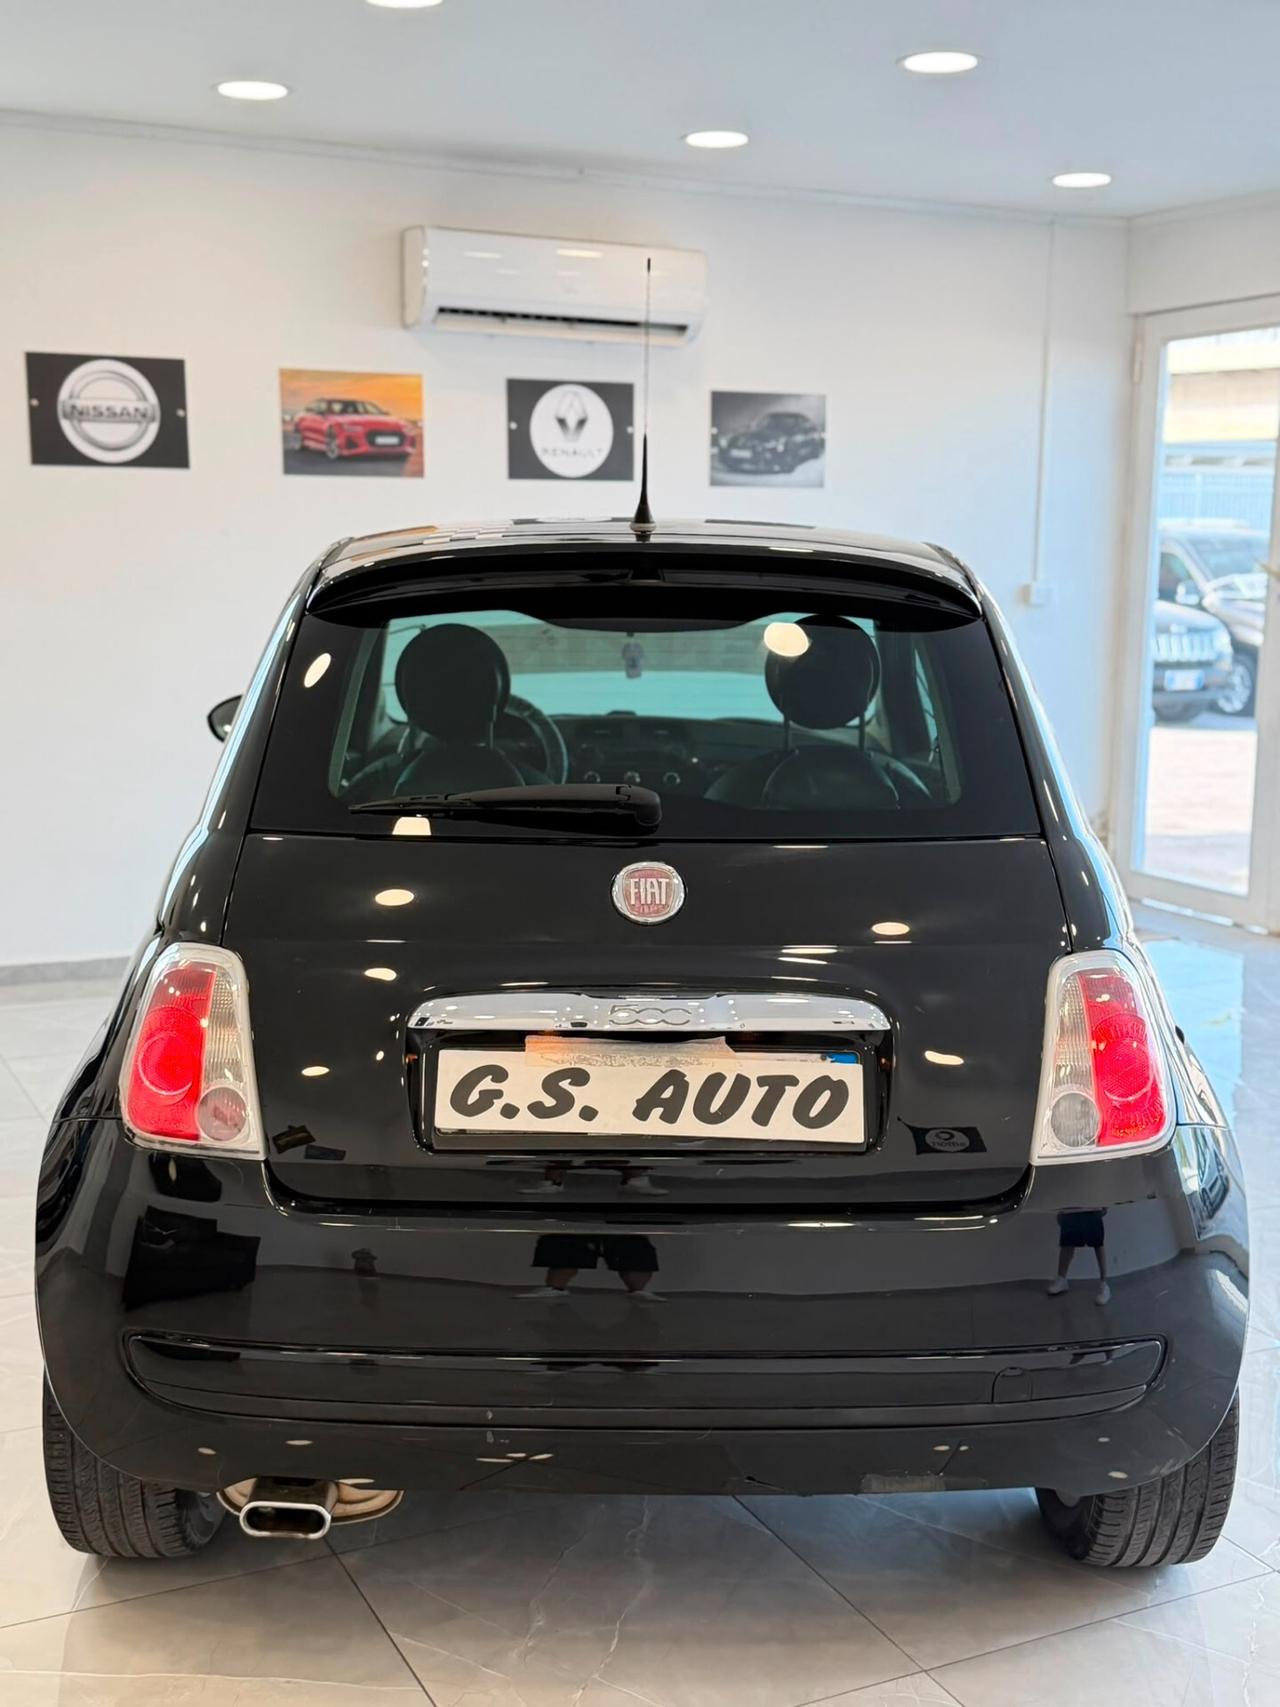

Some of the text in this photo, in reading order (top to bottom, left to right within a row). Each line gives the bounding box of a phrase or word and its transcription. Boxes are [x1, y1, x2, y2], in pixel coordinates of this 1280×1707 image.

[70, 404, 148, 419] NISSAN
[541, 446, 602, 457] RENAULT
[629, 877, 670, 906] FIAT
[609, 1004, 692, 1025] 500
[448, 1063, 850, 1130] G.S. AUTO
